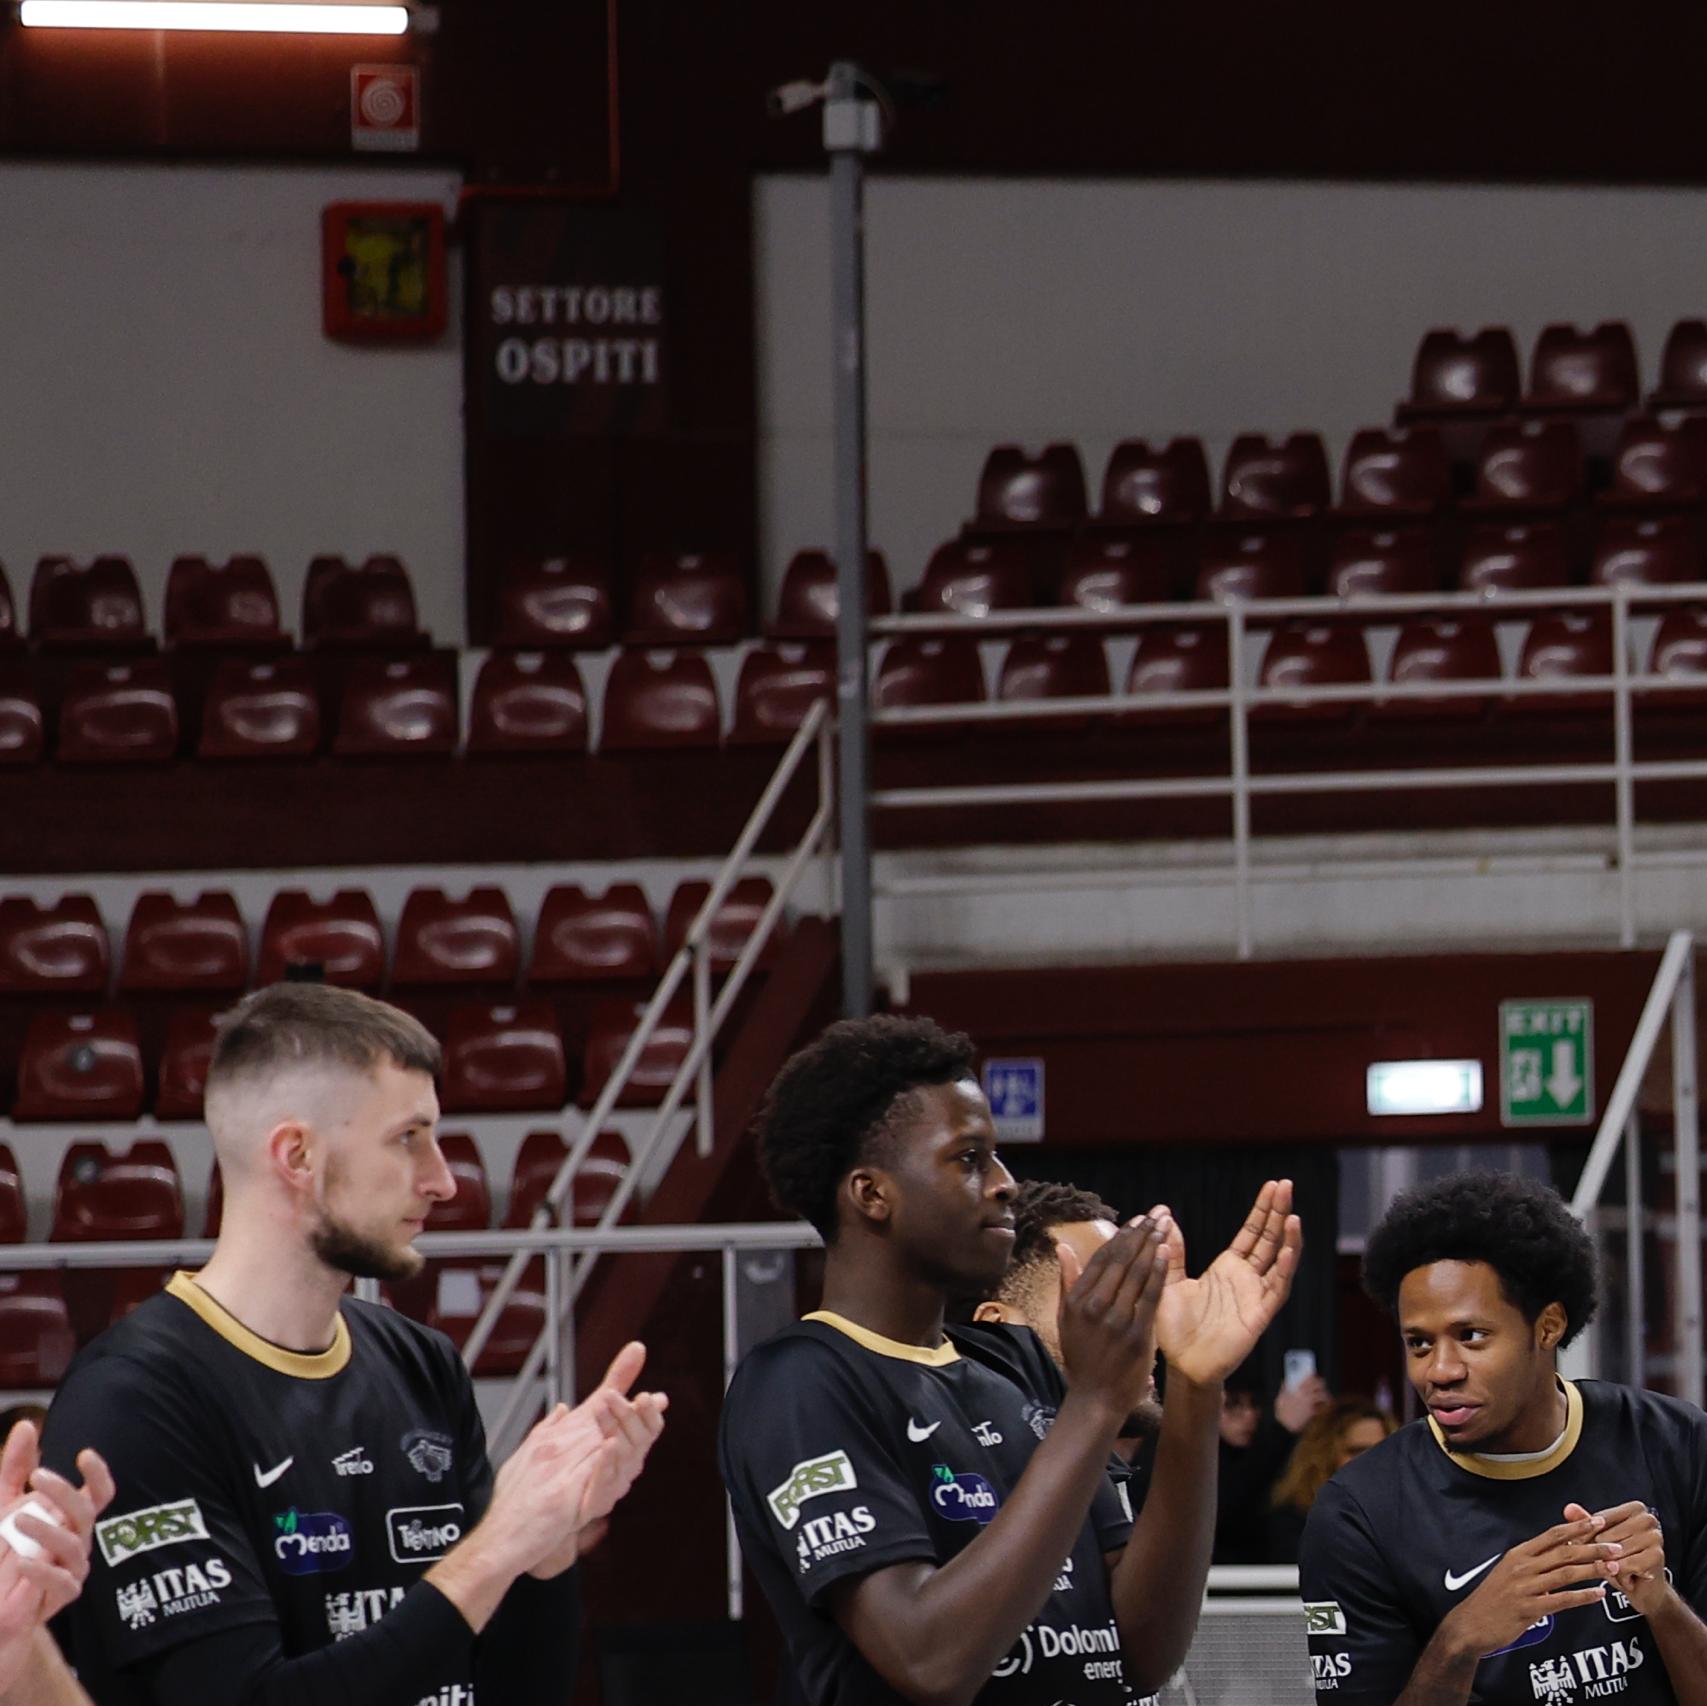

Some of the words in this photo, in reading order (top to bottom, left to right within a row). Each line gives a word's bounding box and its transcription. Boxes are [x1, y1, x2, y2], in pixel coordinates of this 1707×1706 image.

[491, 286, 663, 326] SETTORE
[496, 340, 660, 385] OSPITI
[1507, 1010, 1584, 1036] EXIT
[101, 1504, 199, 1560] FORST
[803, 1506, 876, 1550] ITAS
[815, 1535, 867, 1562] MUTUA
[152, 1558, 233, 1601] ITAS
[163, 1591, 221, 1618] MUTUA
[1038, 1619, 1120, 1658] Dolomi
[1573, 1636, 1644, 1683] ITAS
